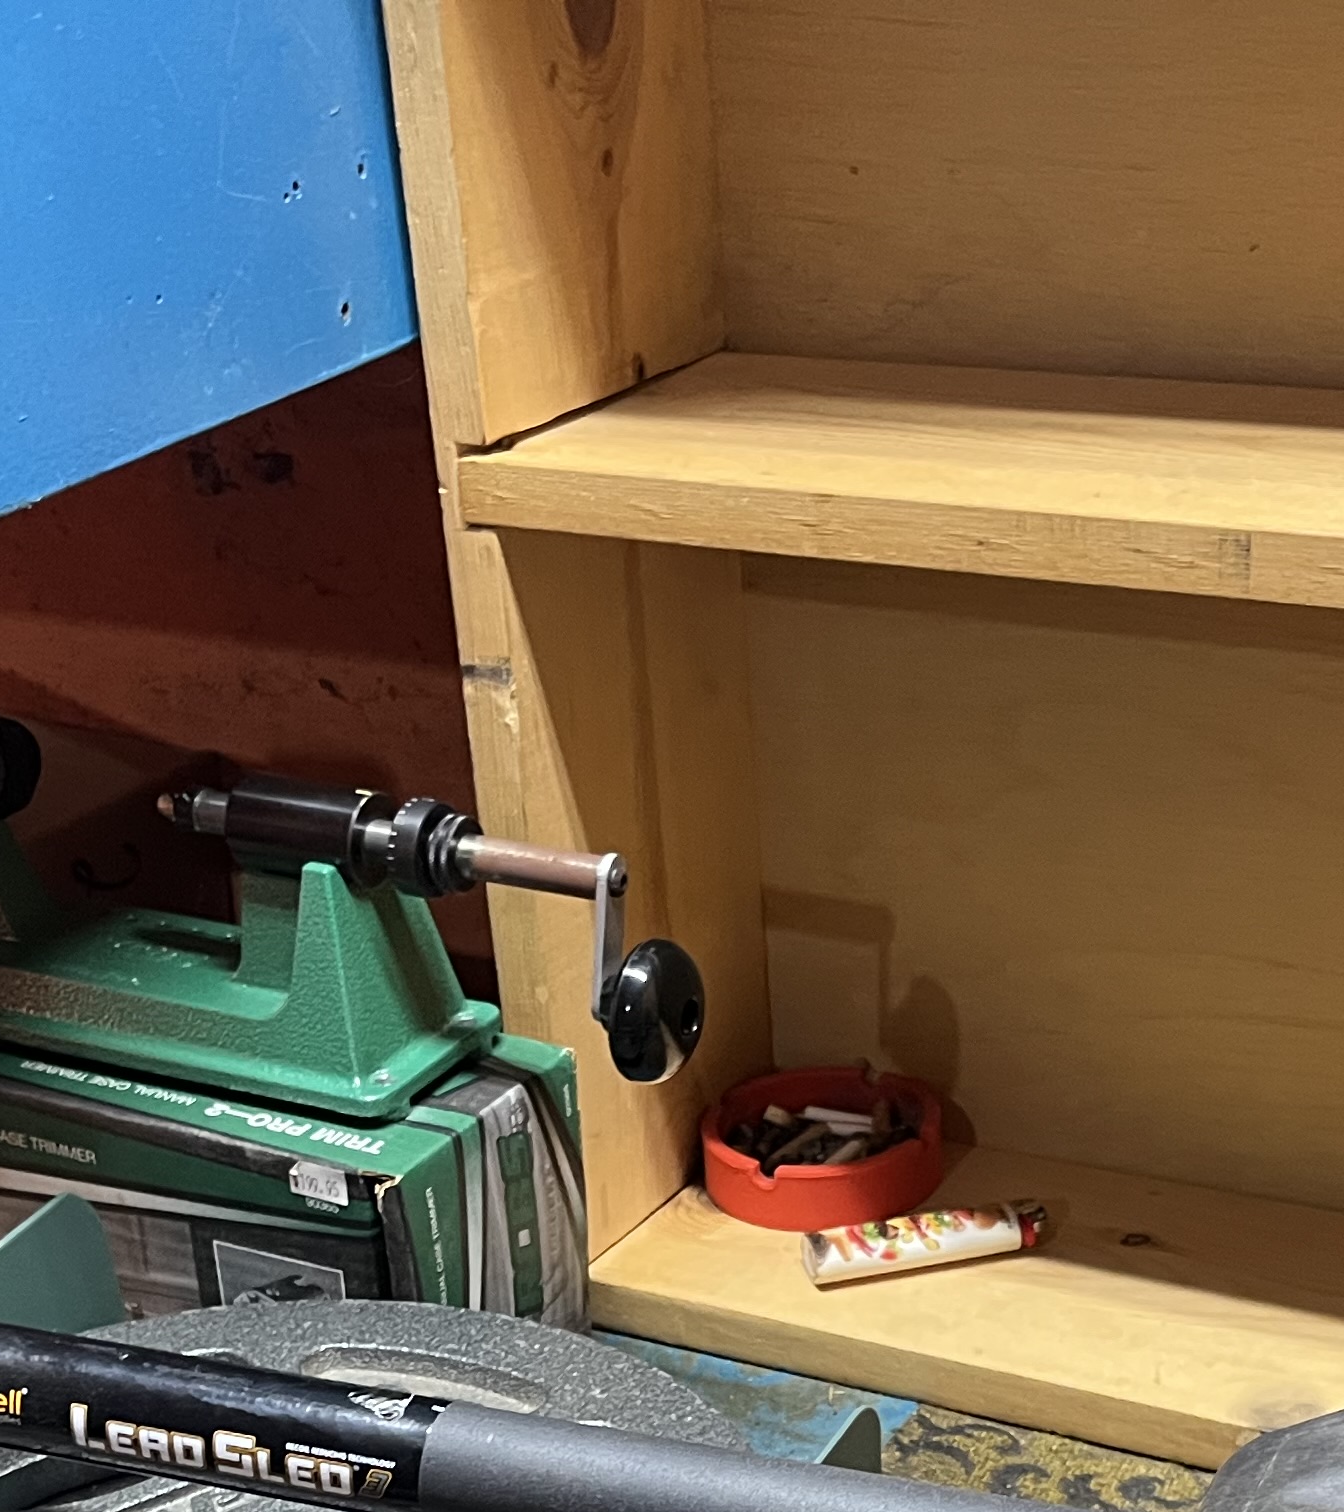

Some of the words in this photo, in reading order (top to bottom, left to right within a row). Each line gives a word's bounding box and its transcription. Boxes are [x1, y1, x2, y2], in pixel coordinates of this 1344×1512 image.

[20, 1060, 87, 1083] TRIMMER
[88, 1075, 132, 1092] CASE
[133, 1083, 197, 1107] MANUAL
[30, 1135, 96, 1166] TRIMMER
[310, 1127, 385, 1156] TRIM
[425, 1186, 439, 1239] TRIMMER
[357, 1468, 393, 1499] 3
